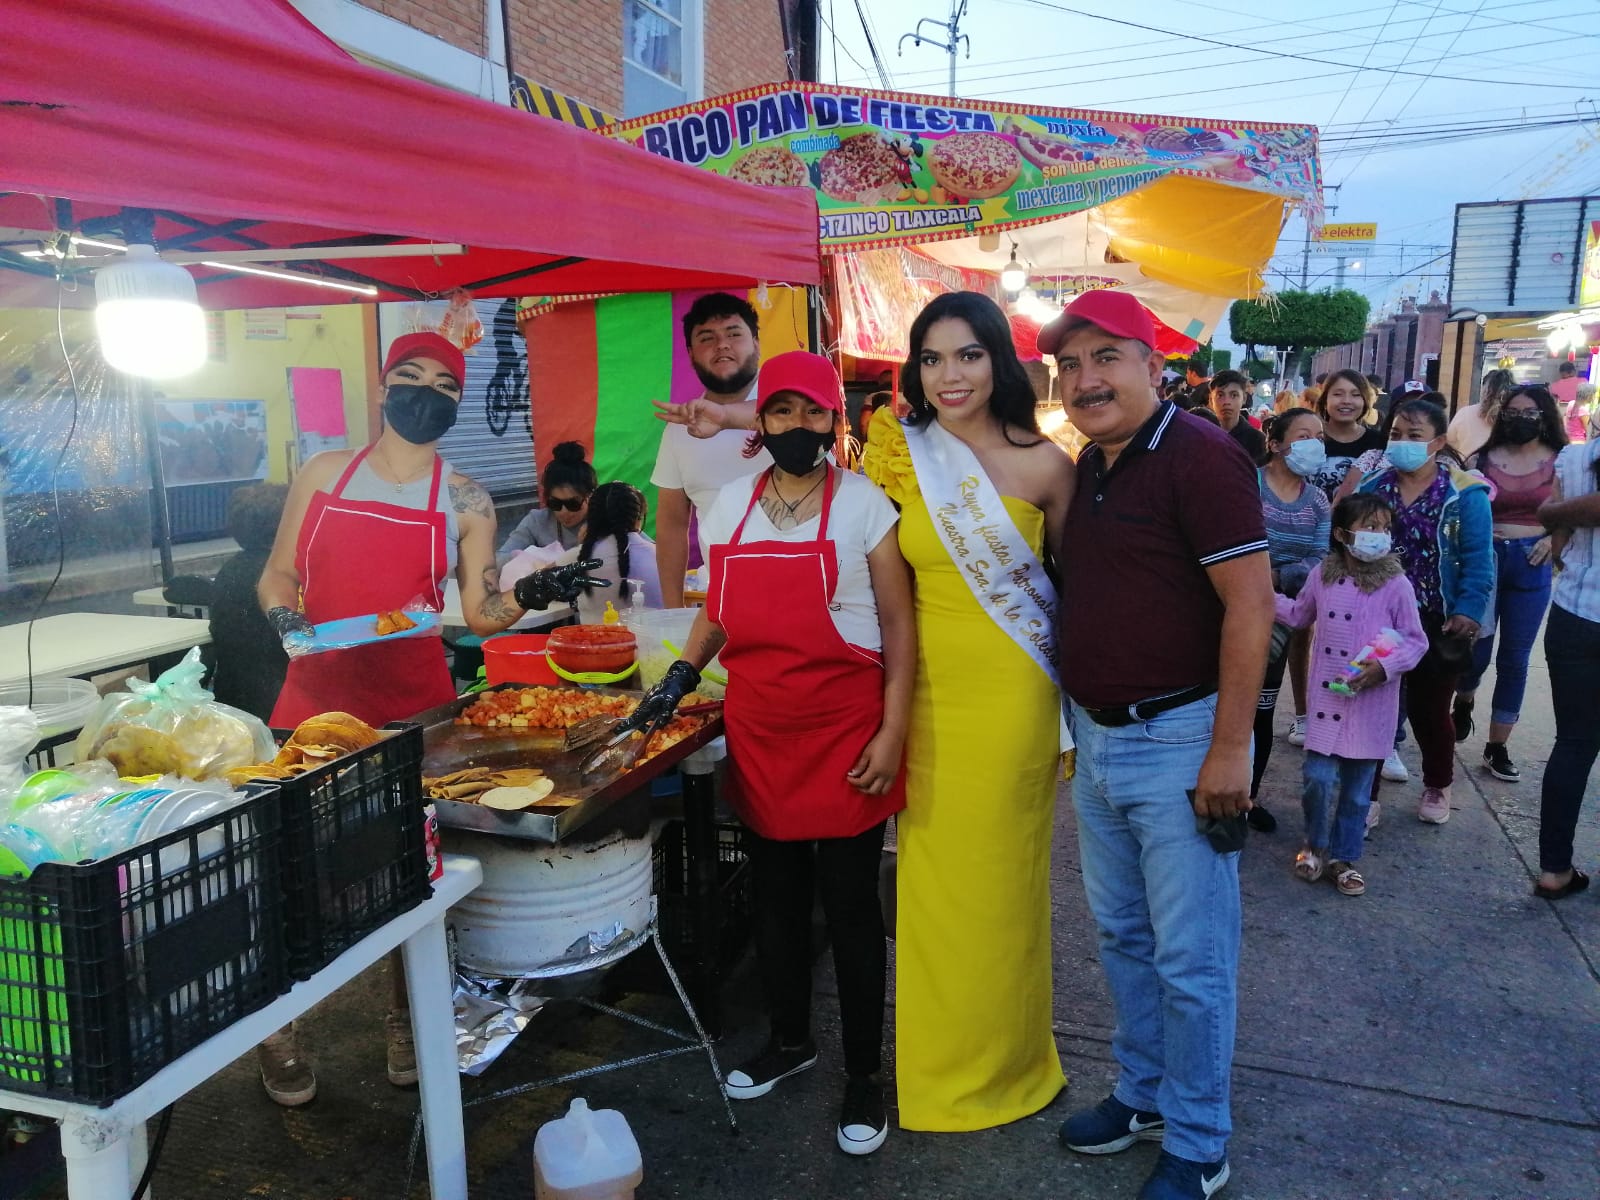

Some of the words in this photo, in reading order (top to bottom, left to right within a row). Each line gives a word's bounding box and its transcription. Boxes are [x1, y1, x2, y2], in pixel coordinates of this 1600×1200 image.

[645, 109, 732, 163] RICO
[737, 91, 807, 148] PAN
[812, 93, 864, 128] DE
[869, 98, 997, 133] FIESTA
[1046, 118, 1107, 137] mixta
[790, 131, 841, 153] combinada
[1042, 162, 1068, 178] son
[1070, 160, 1096, 173] una
[1016, 179, 1085, 210] mexicana
[1085, 179, 1097, 206] y
[892, 206, 983, 231] TLAXCALA
[1329, 226, 1374, 238] elektra
[957, 474, 986, 522] Reyna
[972, 524, 1013, 566] fiestas
[936, 502, 970, 558] Nuestra
[989, 592, 1011, 607] de
